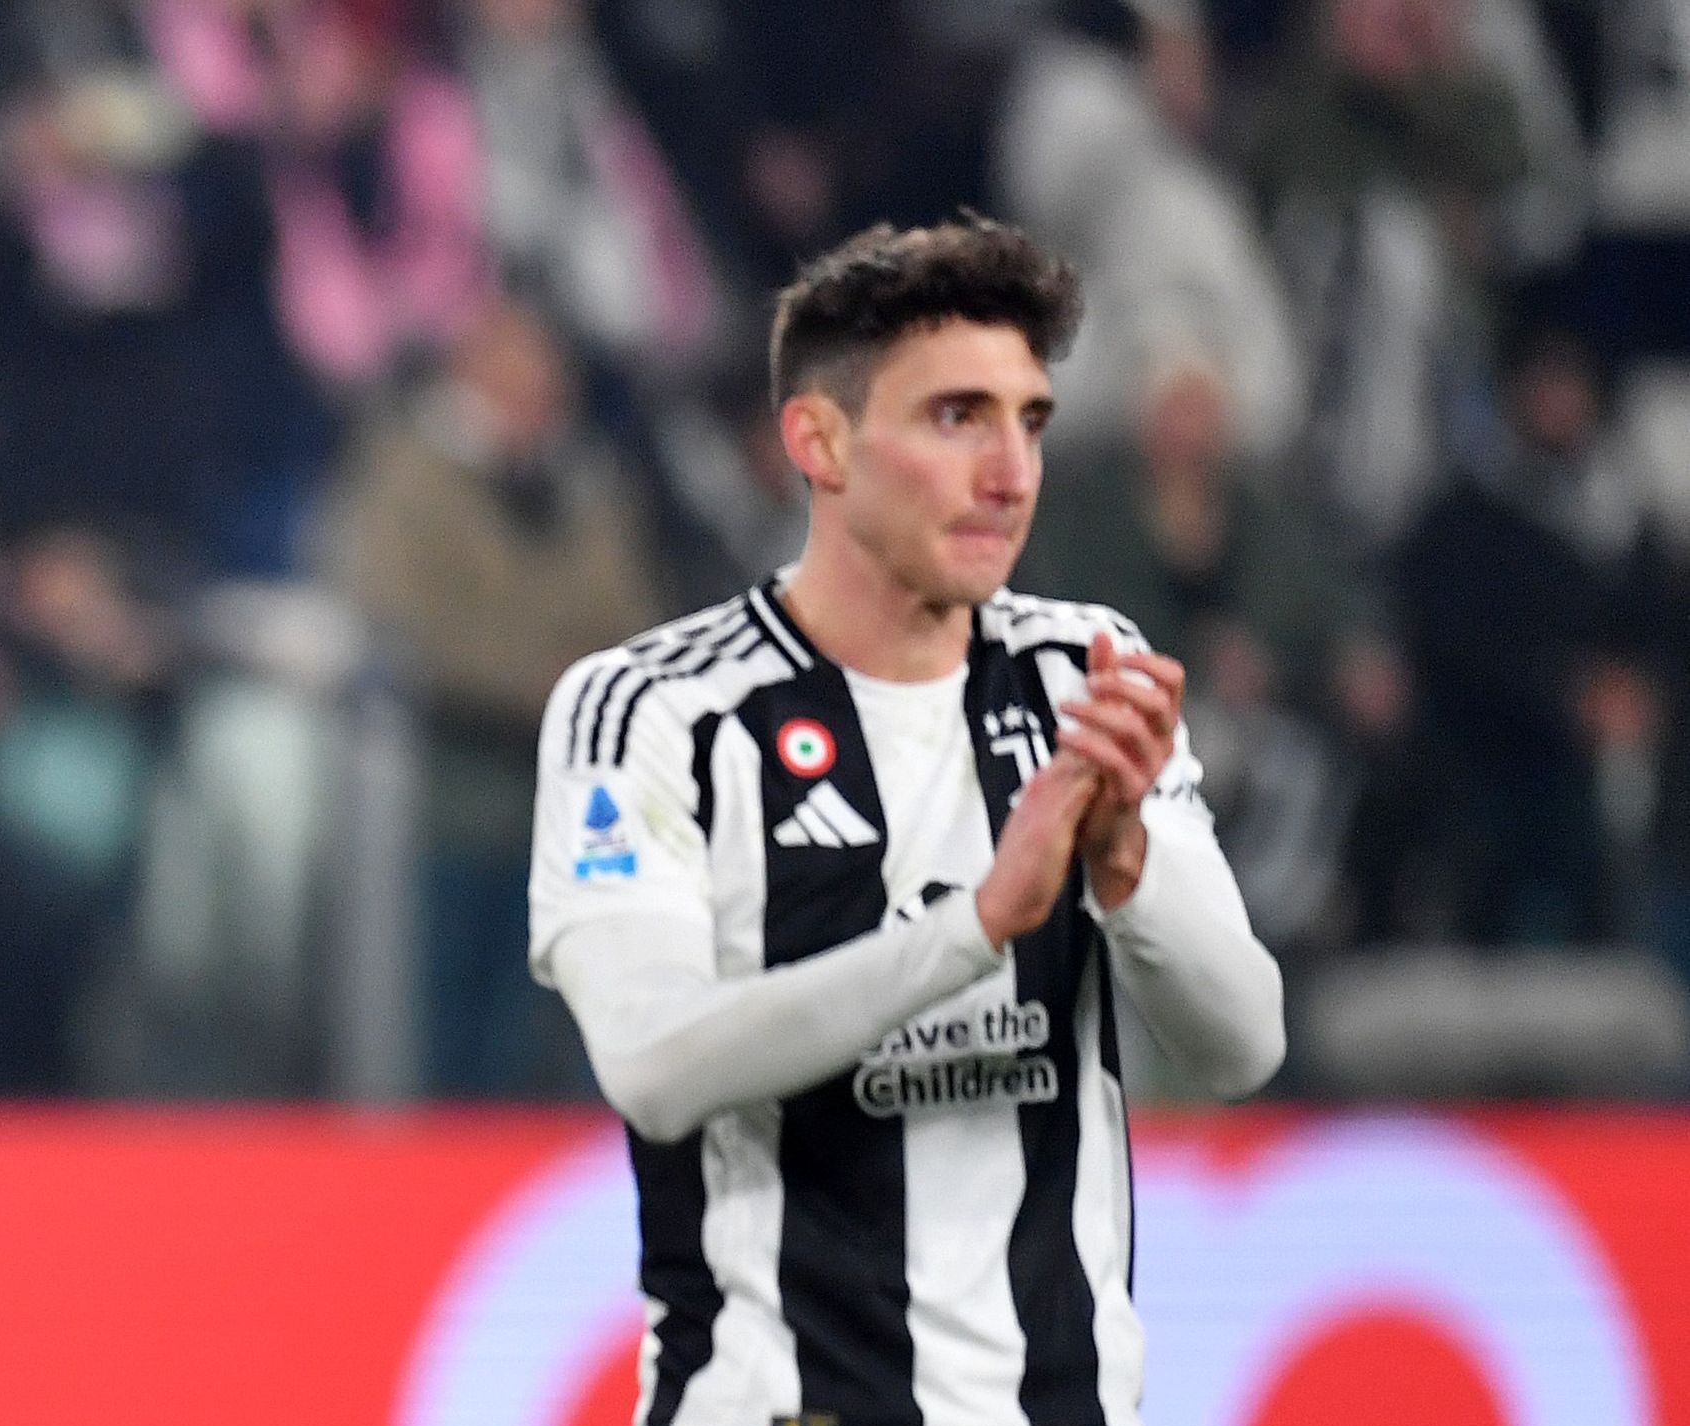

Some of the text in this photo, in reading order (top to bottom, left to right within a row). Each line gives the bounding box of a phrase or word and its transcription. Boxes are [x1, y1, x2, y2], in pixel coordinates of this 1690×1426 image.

[877, 1003, 1041, 1054] ave the
[863, 1057, 1051, 1107] Children
